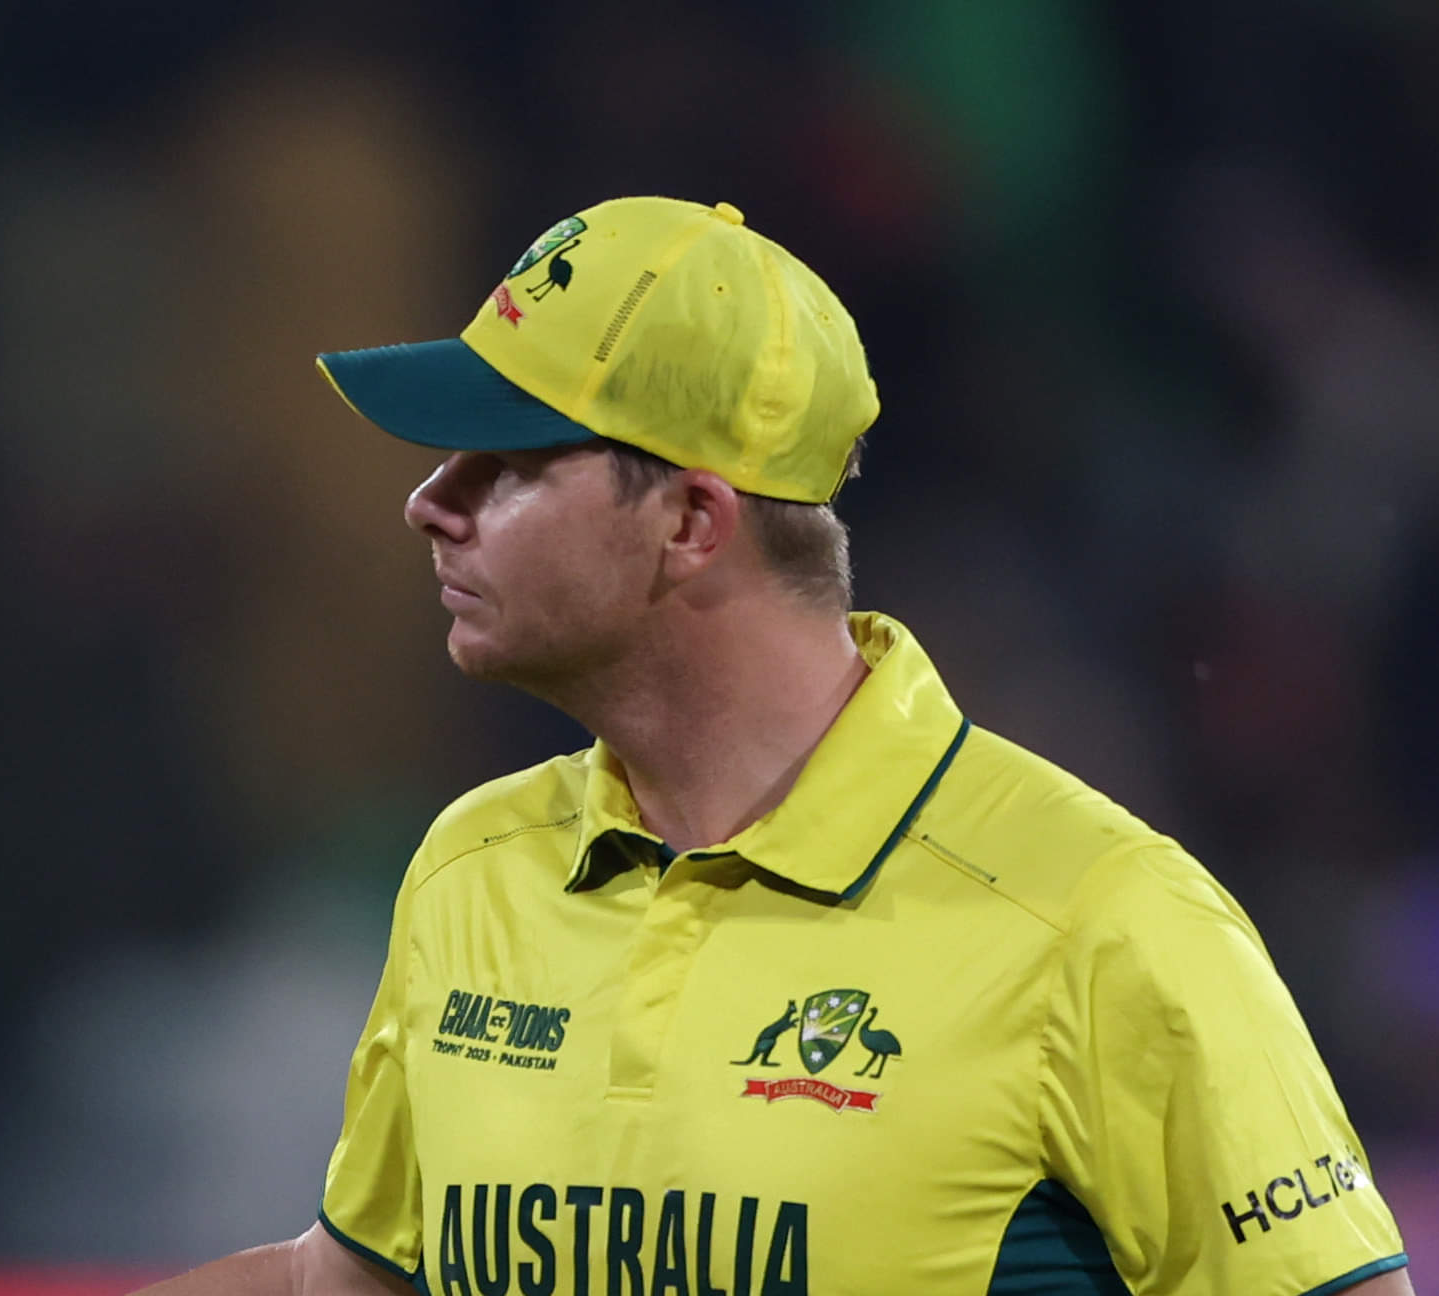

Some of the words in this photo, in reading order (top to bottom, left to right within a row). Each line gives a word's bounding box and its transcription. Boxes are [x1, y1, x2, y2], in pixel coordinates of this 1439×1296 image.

[465, 1046, 492, 1062] 2025
[498, 1053, 557, 1070] PAKISTAN
[774, 1080, 844, 1105] AUSTRALIA
[1221, 1144, 1361, 1244] HCLTe
